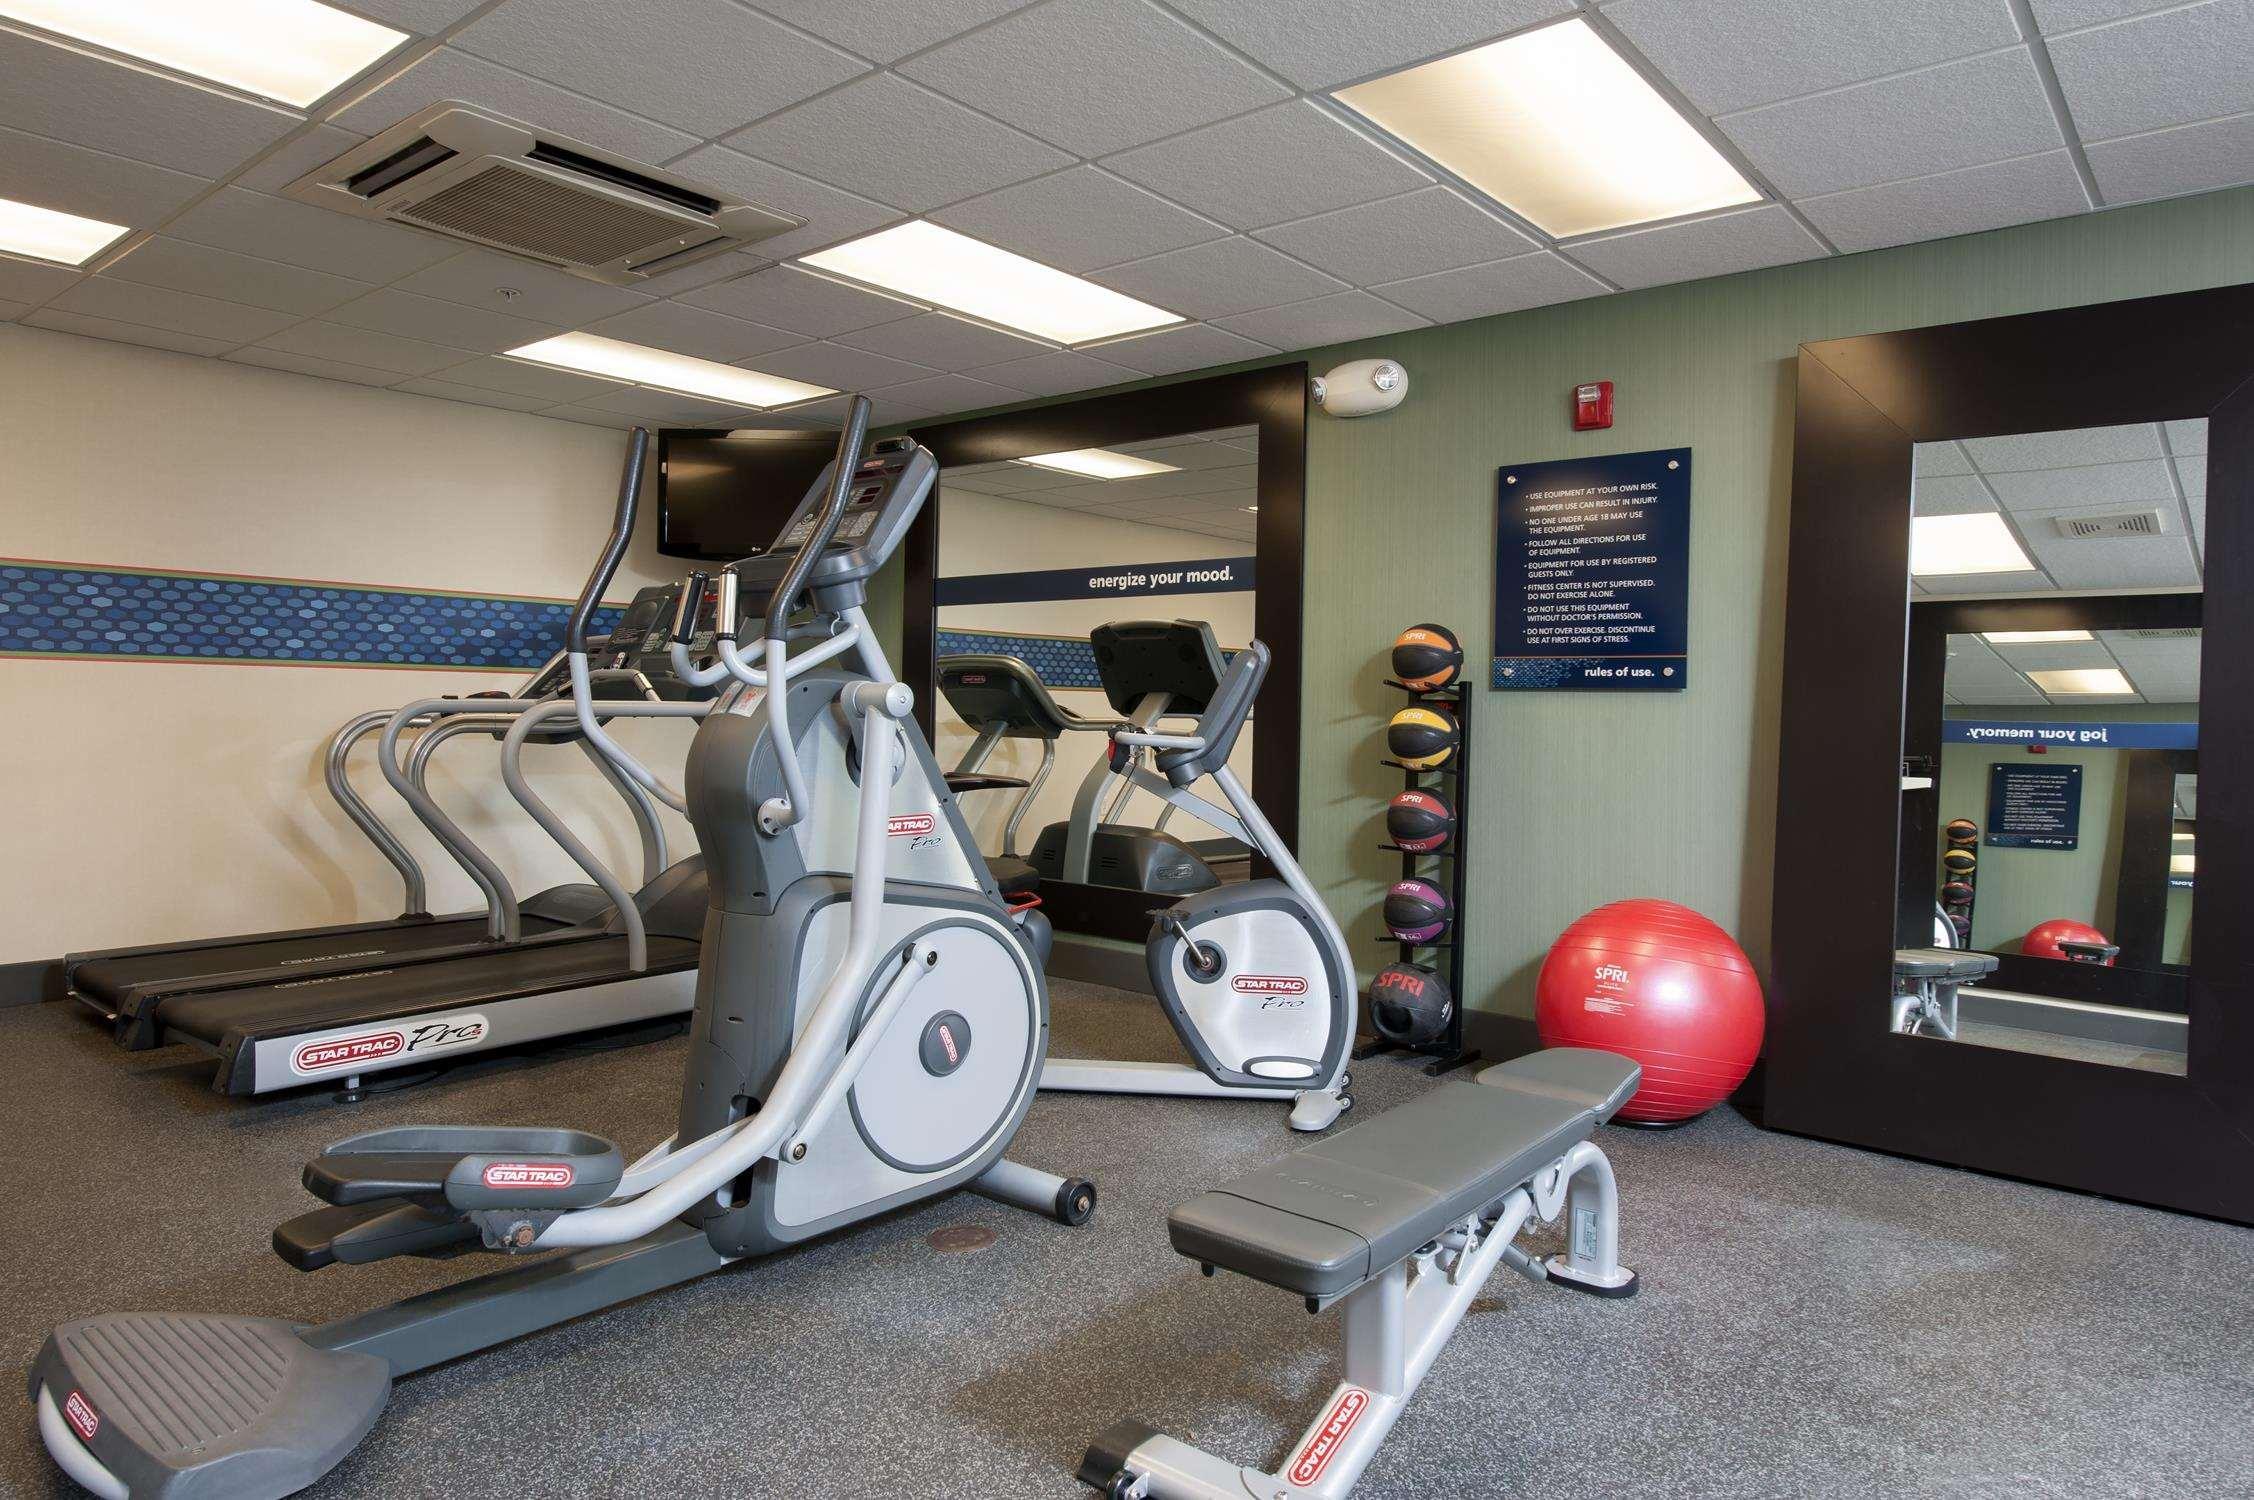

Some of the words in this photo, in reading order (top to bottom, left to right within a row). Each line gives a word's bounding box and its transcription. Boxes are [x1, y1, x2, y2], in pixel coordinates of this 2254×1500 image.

[1544, 489, 1585, 498] EQUIPMENT
[1530, 504, 1563, 513] IMPROPER
[1596, 500, 1620, 508] RESULT
[1544, 525, 1585, 533] EQUIPMENT.
[1573, 536, 1614, 544] DIRECTIONS
[1540, 547, 1580, 555] EQUIPMENT.
[1529, 561, 1568, 570] EQUIPMENT
[1613, 556, 1657, 565] REGISTERED
[1089, 572, 1146, 590] energize
[1150, 572, 1183, 588] your
[1186, 566, 1234, 583] mood.
[1610, 579, 1655, 587] SUPERVISED.
[1587, 603, 1629, 611] EQUIPMENT
[1527, 614, 1559, 622] WITHOUT
[1561, 613, 1596, 621] DOCTOR'S
[1598, 612, 1642, 620] PERMISSION.
[1585, 667, 1613, 676] rules
[1616, 667, 1629, 676] of
[1402, 711, 1424, 720] SPRI
[1401, 794, 1422, 804] SPRI
[903, 820, 930, 830] TRAC
[1399, 882, 1420, 892] SPRI
[1594, 966, 1628, 982] SPRI
[1235, 980, 1269, 988] STAR
[1270, 982, 1302, 990] TRAC
[1377, 972, 1424, 997] SPRI
[302, 1047, 349, 1064] STAR
[352, 1038, 396, 1054] TRAC
[490, 1170, 526, 1180] STAR
[528, 1170, 565, 1180] TRAC
[70, 1398, 82, 1417] STAR
[80, 1410, 94, 1431] TRAC
[1328, 1393, 1362, 1436] STAR
[1300, 1434, 1334, 1478] TRAC
